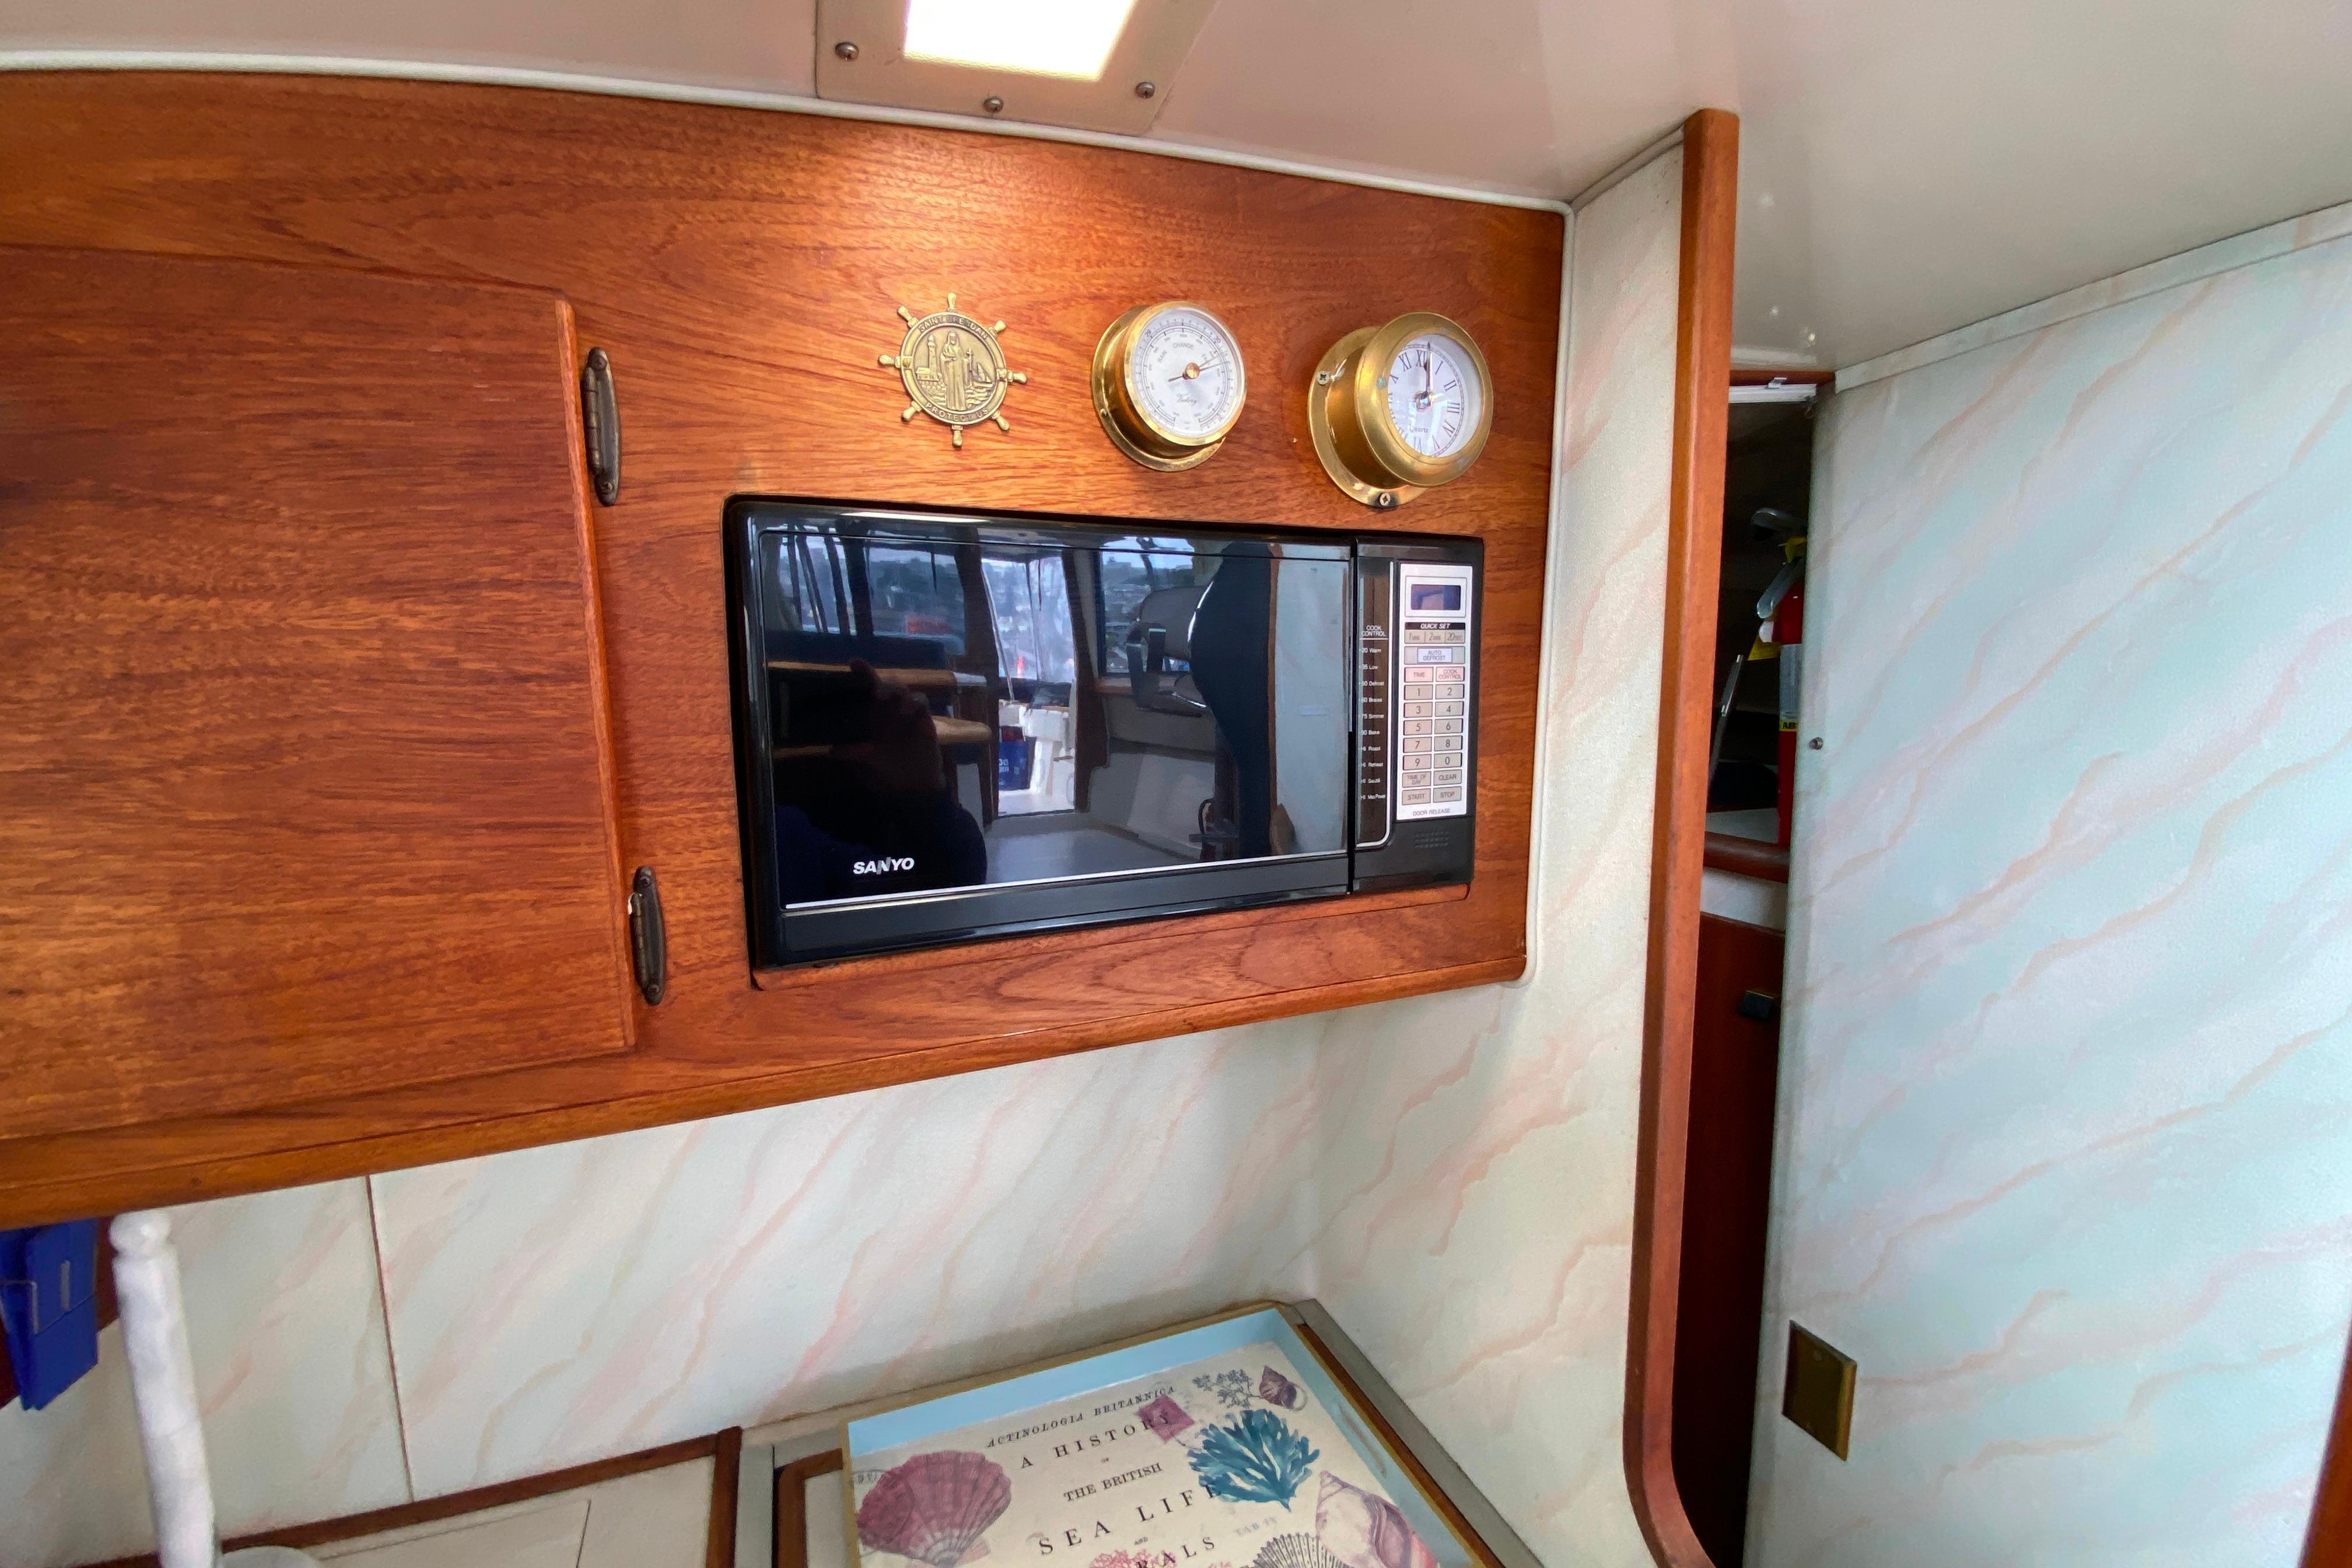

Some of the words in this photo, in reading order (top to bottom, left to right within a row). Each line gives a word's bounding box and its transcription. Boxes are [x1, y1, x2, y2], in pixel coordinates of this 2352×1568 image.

[919, 316, 943, 332] SAINT
[947, 316, 988, 338] BRENDAN
[1399, 352, 1412, 372] XI
[1444, 379, 1457, 391] II
[926, 402, 972, 421] PROTECT
[976, 408, 988, 418] US
[1447, 402, 1460, 414] III
[1447, 687, 1452, 696] 2
[1416, 706, 1421, 714] 3
[1446, 705, 1451, 713] 4
[1415, 723, 1420, 732] 5
[1446, 722, 1451, 730] 6
[1415, 741, 1420, 749] 7
[1446, 739, 1450, 748] 8
[1415, 758, 1420, 766] 9
[1445, 757, 1450, 765] 0
[853, 857, 915, 874] SANYO
[987, 1413, 1084, 1448] ACTINOLOGIA
[1094, 1385, 1175, 1416] BRITANNICA
[1021, 1457, 1034, 1469] A
[1063, 1484, 1097, 1502] THE
[1101, 1462, 1163, 1490] BRITISH
[1039, 1520, 1111, 1556] SEA
